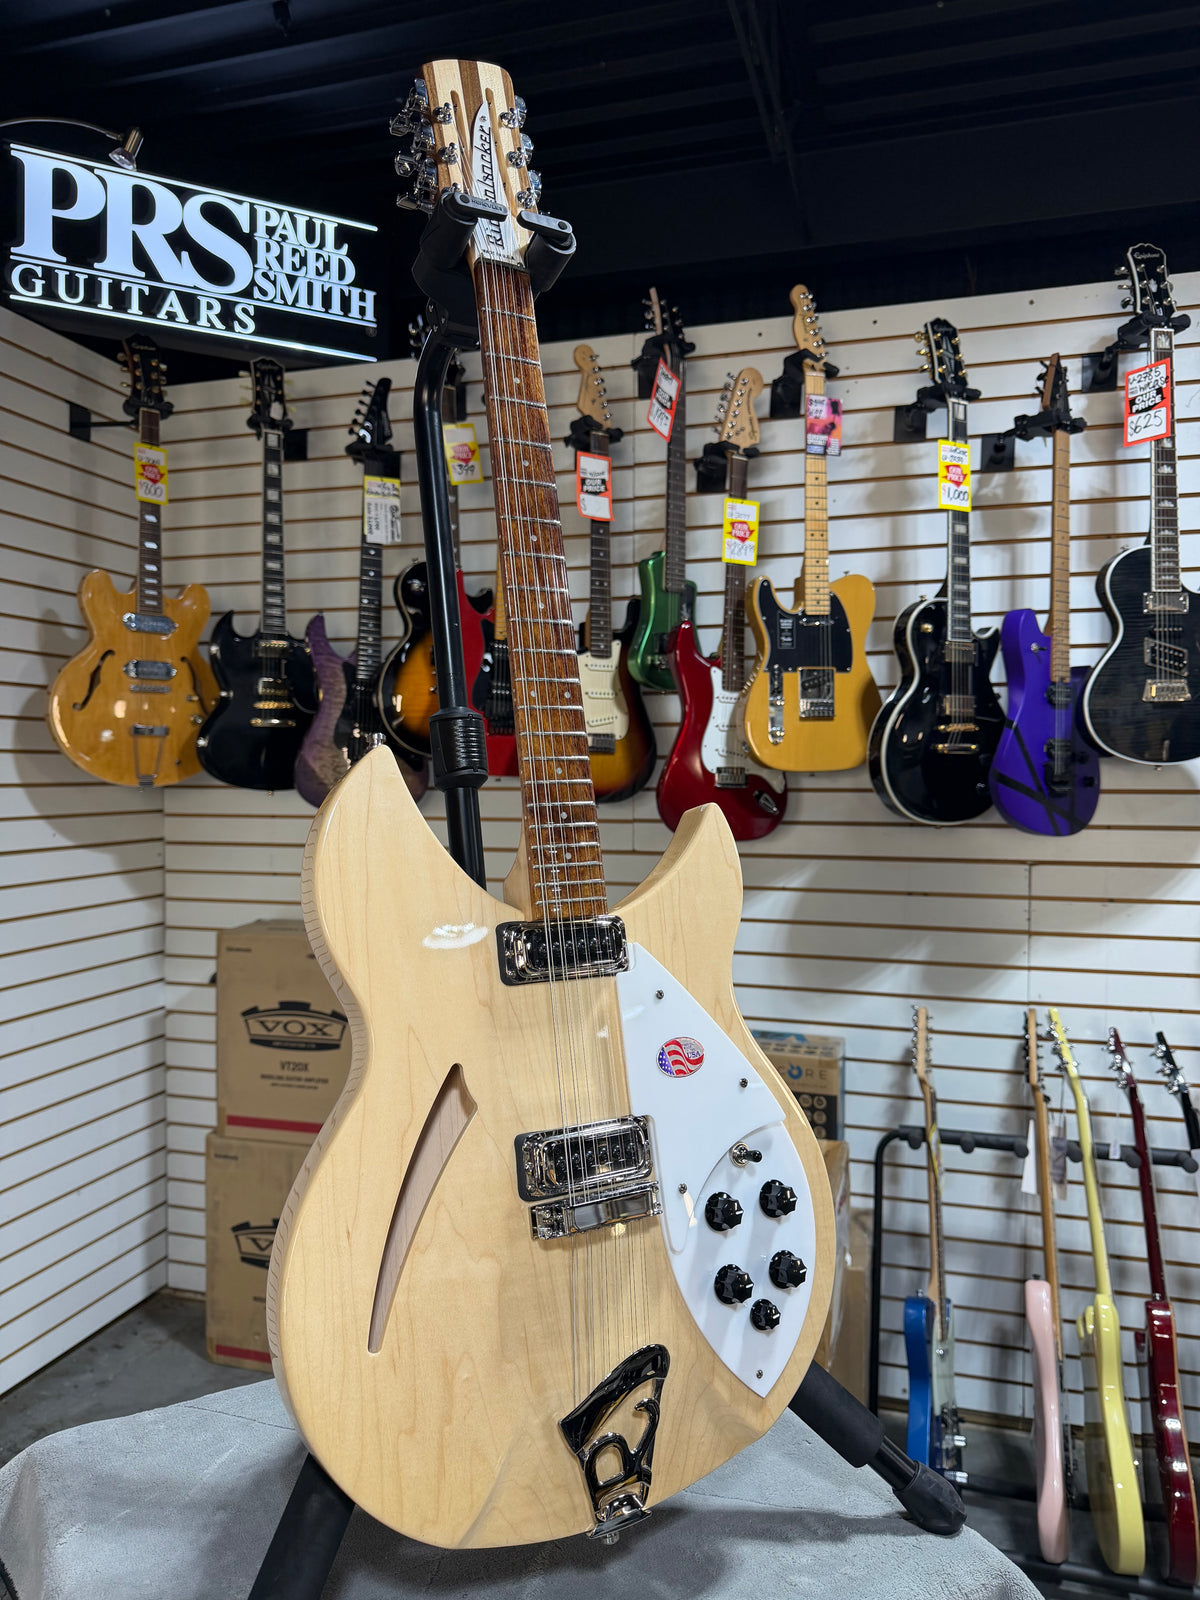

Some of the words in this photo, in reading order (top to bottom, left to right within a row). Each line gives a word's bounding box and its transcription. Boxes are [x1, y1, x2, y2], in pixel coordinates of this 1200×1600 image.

[474, 125, 504, 250] Ricnbacker
[10, 150, 253, 294] PRS
[253, 204, 349, 256] PAUL
[253, 236, 356, 286] REED
[10, 264, 256, 334] GUITARS
[253, 268, 377, 322] SMITH
[1131, 394, 1162, 413] PRICE
[1135, 390, 1157, 404] OUR
[1129, 409, 1163, 437] $625
[582, 485, 606, 493] PRICE
[258, 1019, 334, 1038] VOX
[686, 1051, 701, 1059] USA
